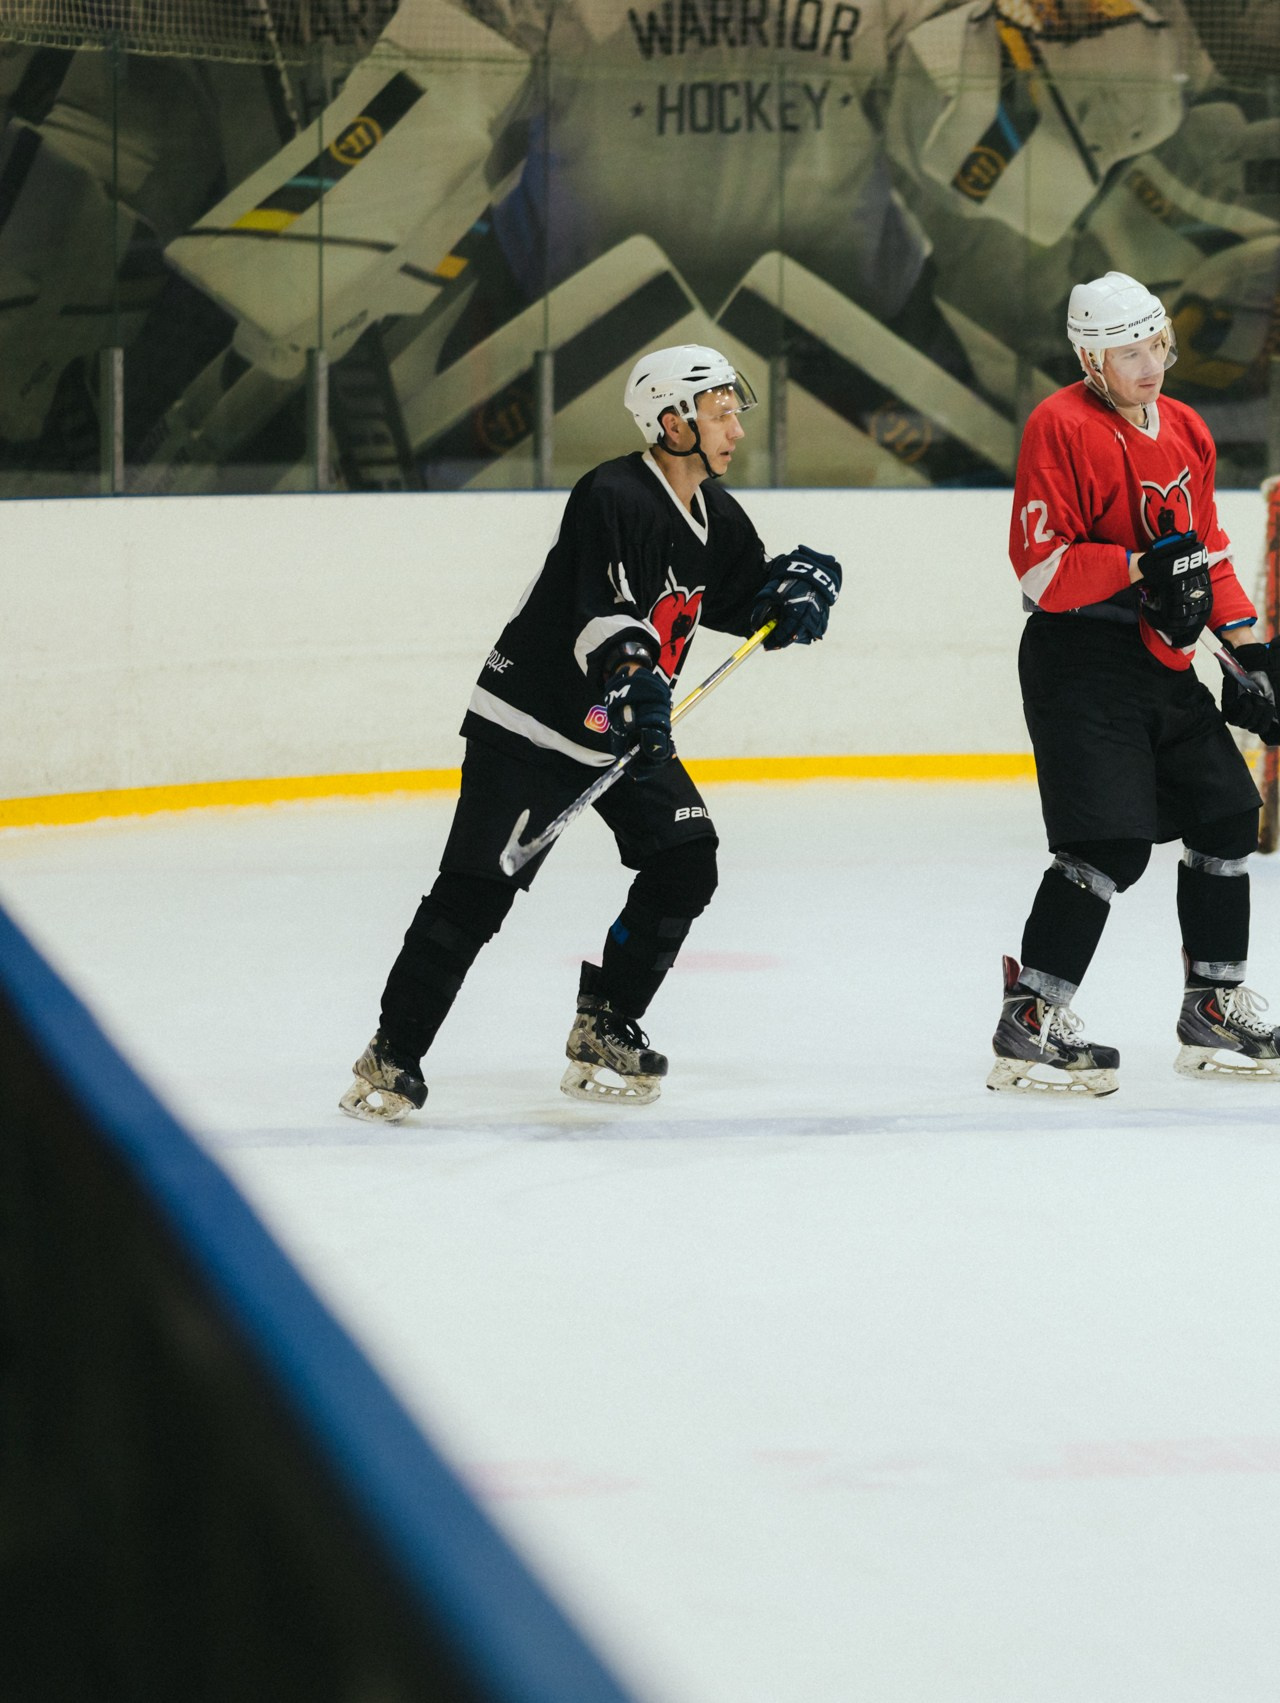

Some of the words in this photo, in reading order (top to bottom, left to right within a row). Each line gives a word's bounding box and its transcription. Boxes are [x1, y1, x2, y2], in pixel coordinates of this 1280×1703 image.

[628, 0, 861, 60] WARRIOR
[656, 79, 831, 135] HOCKEY
[1020, 499, 1056, 551] 12
[786, 560, 839, 601] CCM
